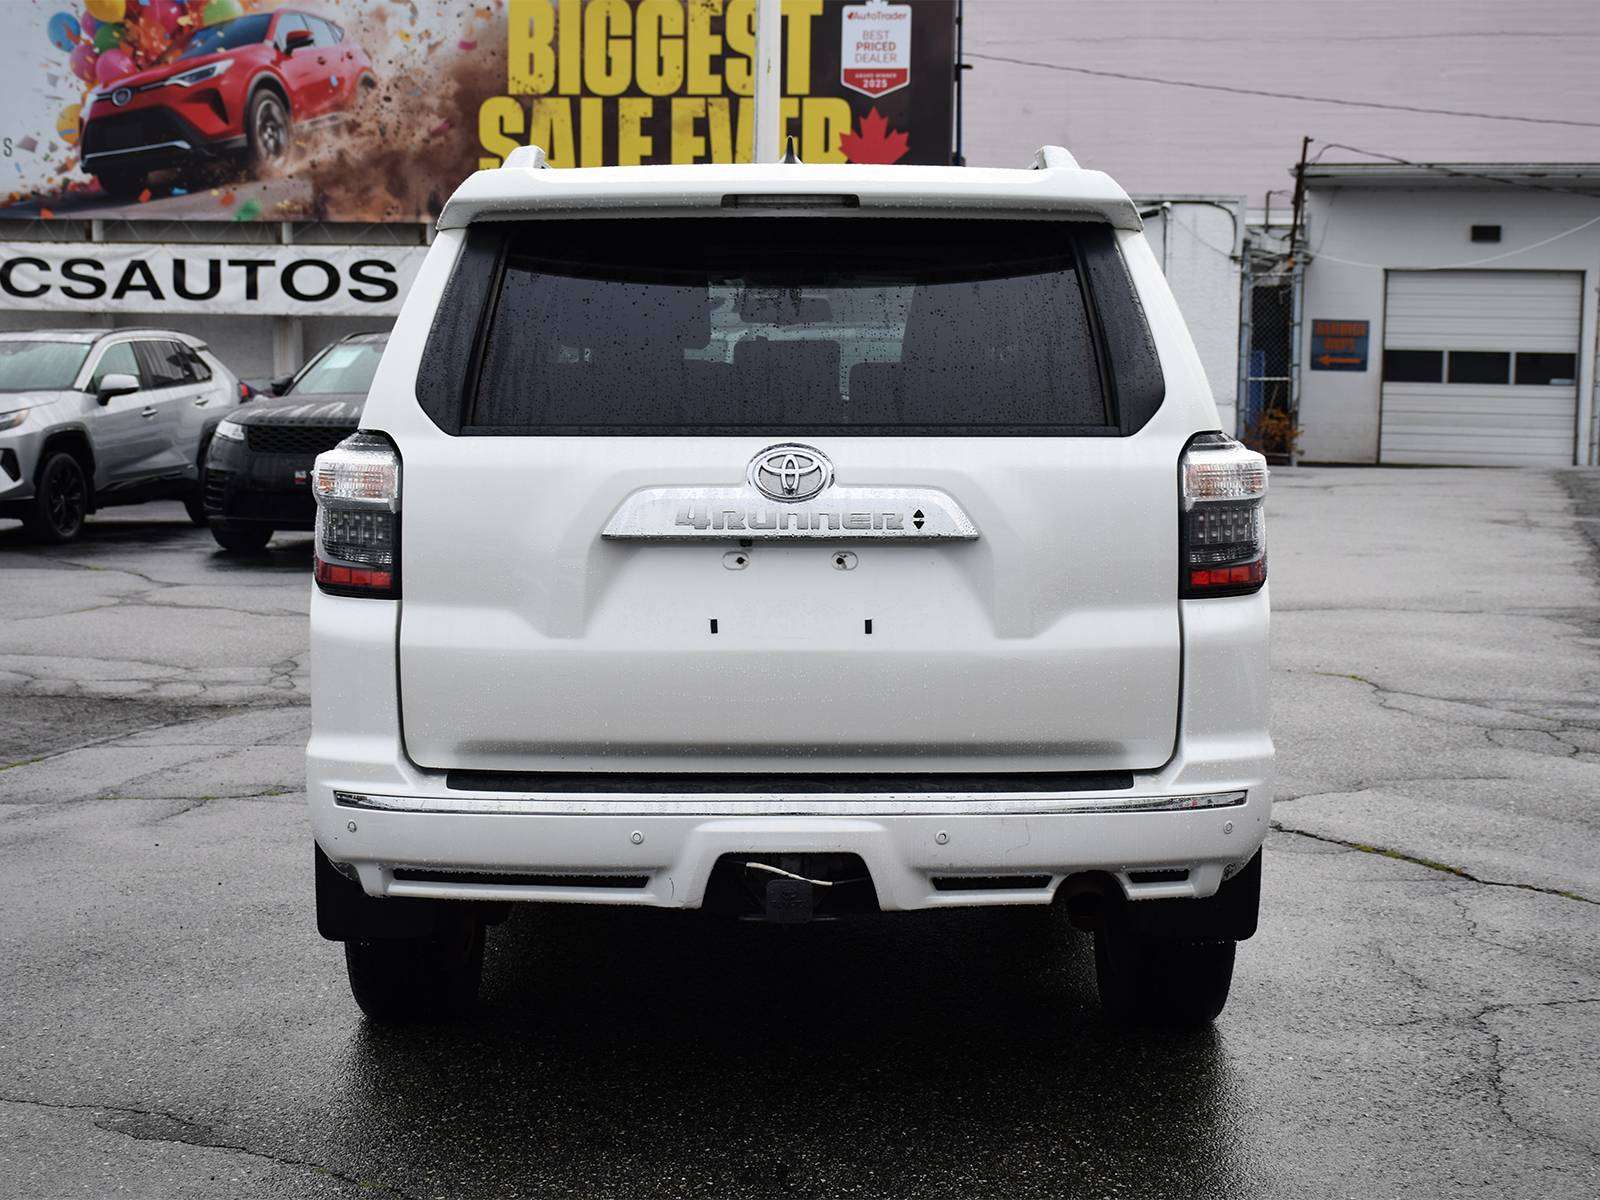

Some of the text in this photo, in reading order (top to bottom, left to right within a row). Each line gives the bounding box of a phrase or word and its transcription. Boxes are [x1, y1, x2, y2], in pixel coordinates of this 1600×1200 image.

[853, 12, 906, 20] AutoTrader
[862, 30, 889, 40] BEST
[508, 0, 823, 96] BIGGEST
[856, 42, 897, 51] PRICED
[855, 53, 897, 63] DEALER
[863, 79, 888, 88] 2025
[0, 257, 400, 302] CSAUTOS
[675, 505, 905, 530] 4RUNNER
